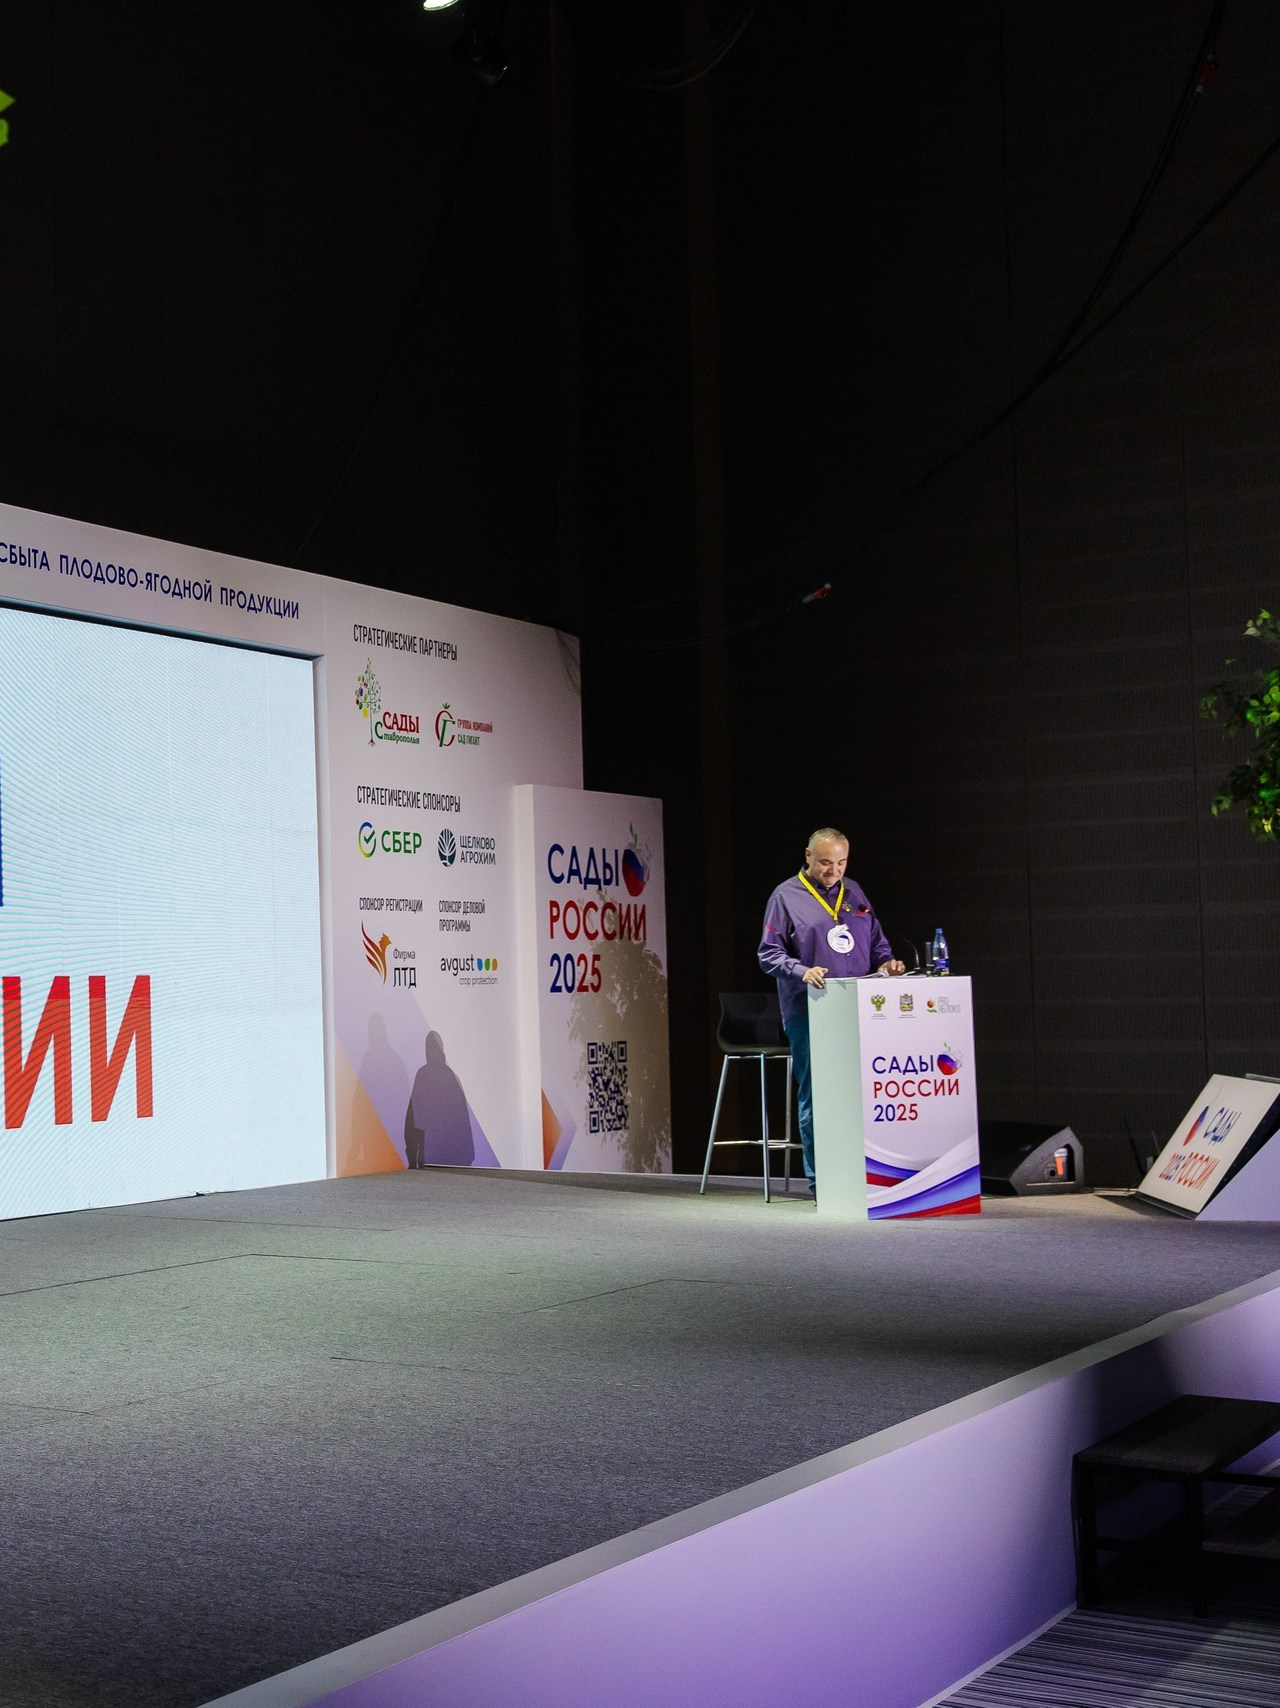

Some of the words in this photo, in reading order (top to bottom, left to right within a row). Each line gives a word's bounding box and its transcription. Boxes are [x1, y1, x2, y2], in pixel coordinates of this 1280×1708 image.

[59, 554, 213, 603] ПЛОДОВО-ЯГОДНОЙ
[220, 587, 300, 619] ПРОДУКЦИИ
[353, 624, 418, 653] СТРАТЕГИЧЕСКИЕ
[419, 638, 458, 661] ПАРТНЕРЫ
[382, 711, 420, 734] САДЫ
[357, 785, 421, 809] СТРАТЕГИЧЕСКИЕ
[422, 792, 461, 813] СПОНСОРЫ
[381, 830, 422, 854] СБЕР
[459, 834, 496, 850] ЩЕЛКОВО
[460, 851, 496, 866] АГРОХИМ
[547, 843, 619, 891] САДЫ
[359, 897, 384, 911] СПОНСОР
[385, 898, 424, 914] РЕГИСТРАЦИИ
[438, 900, 462, 914] СПОНСОР
[462, 899, 486, 916] ДЕЛОВОЙ
[438, 919, 471, 932] ПРОГРАММЫ
[549, 900, 647, 942] РОССИИ
[393, 948, 416, 962] Фирма
[440, 954, 475, 976] avgust
[393, 967, 417, 989] ЛТД
[549, 953, 602, 993] 2025
[872, 1055, 934, 1075] САДЫ
[873, 1078, 960, 1099] РОССИИ
[873, 1103, 919, 1122] 2025
[1203, 1107, 1242, 1147] САДЫ
